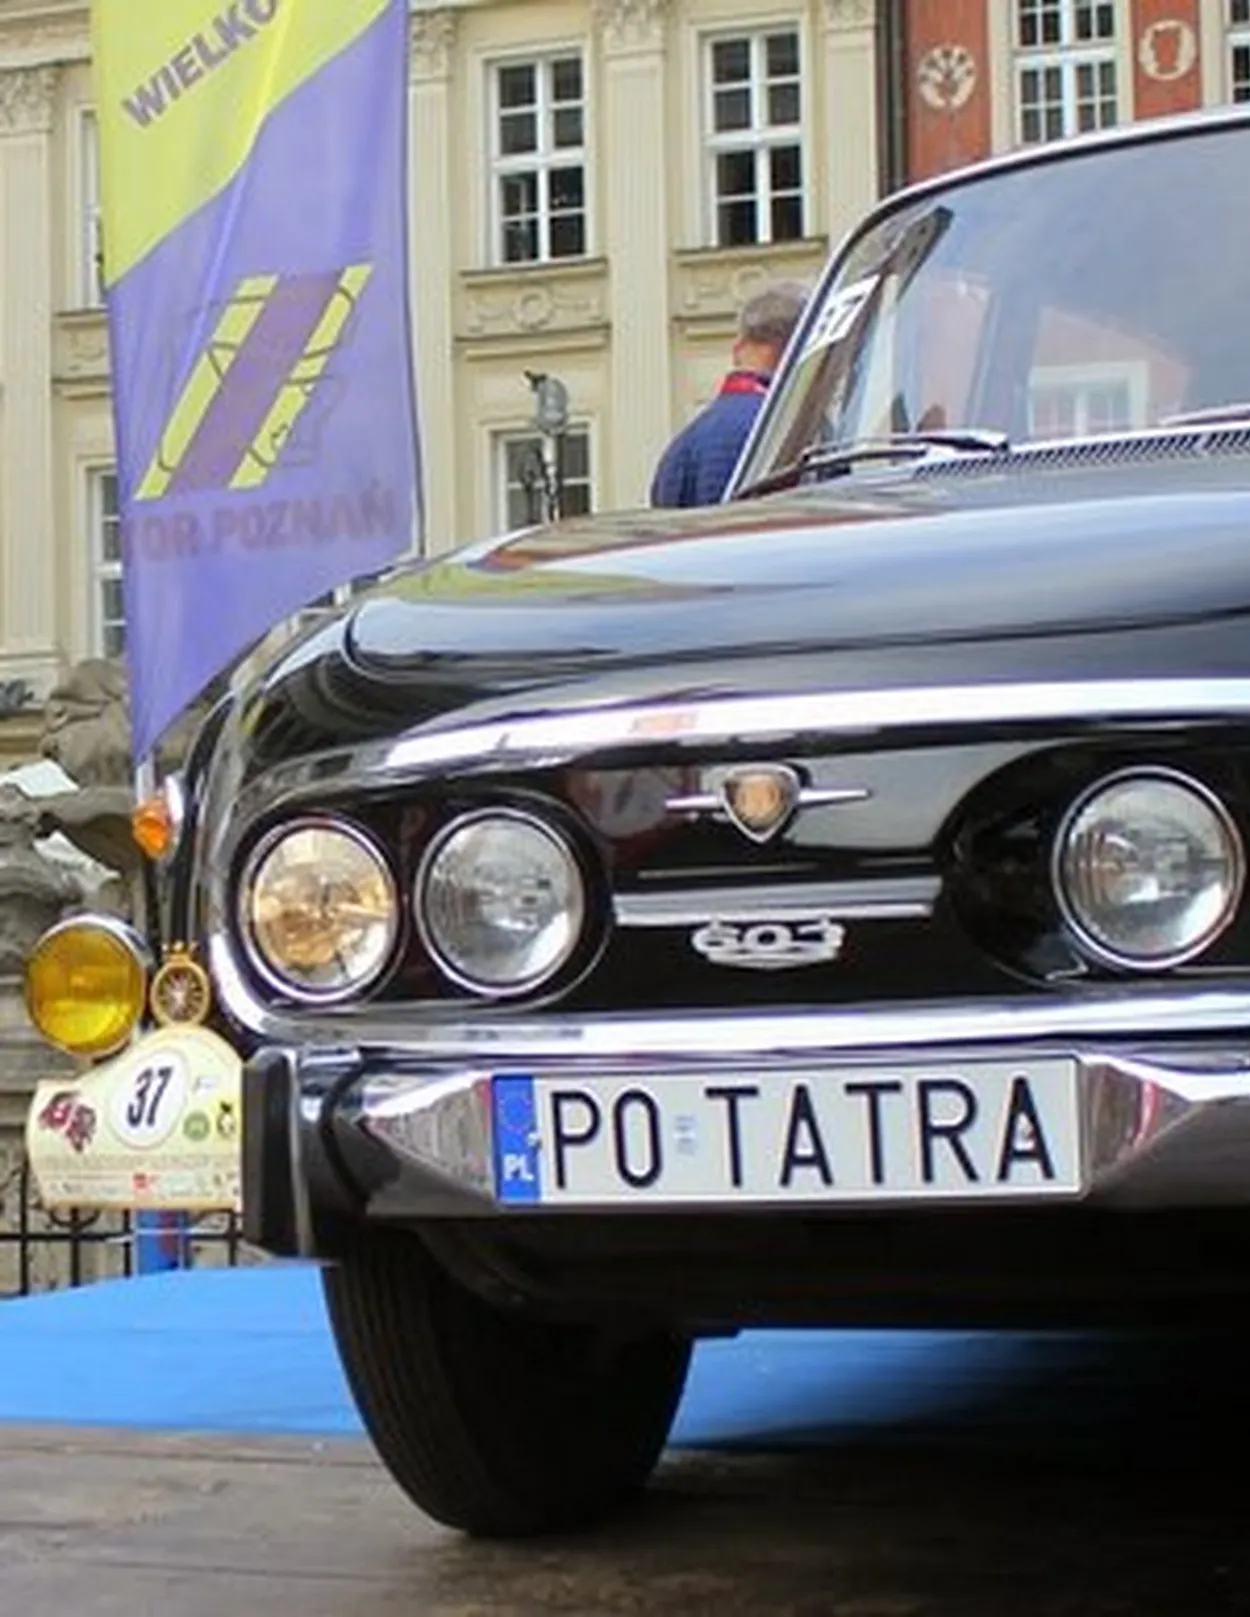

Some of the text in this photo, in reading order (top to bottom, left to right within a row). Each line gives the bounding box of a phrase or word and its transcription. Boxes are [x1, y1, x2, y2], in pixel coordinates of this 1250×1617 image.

[692, 921, 846, 963] 603
[126, 1066, 174, 1129] 37
[550, 1076, 1055, 1189] PO TATRA
[503, 1154, 535, 1181] PL
